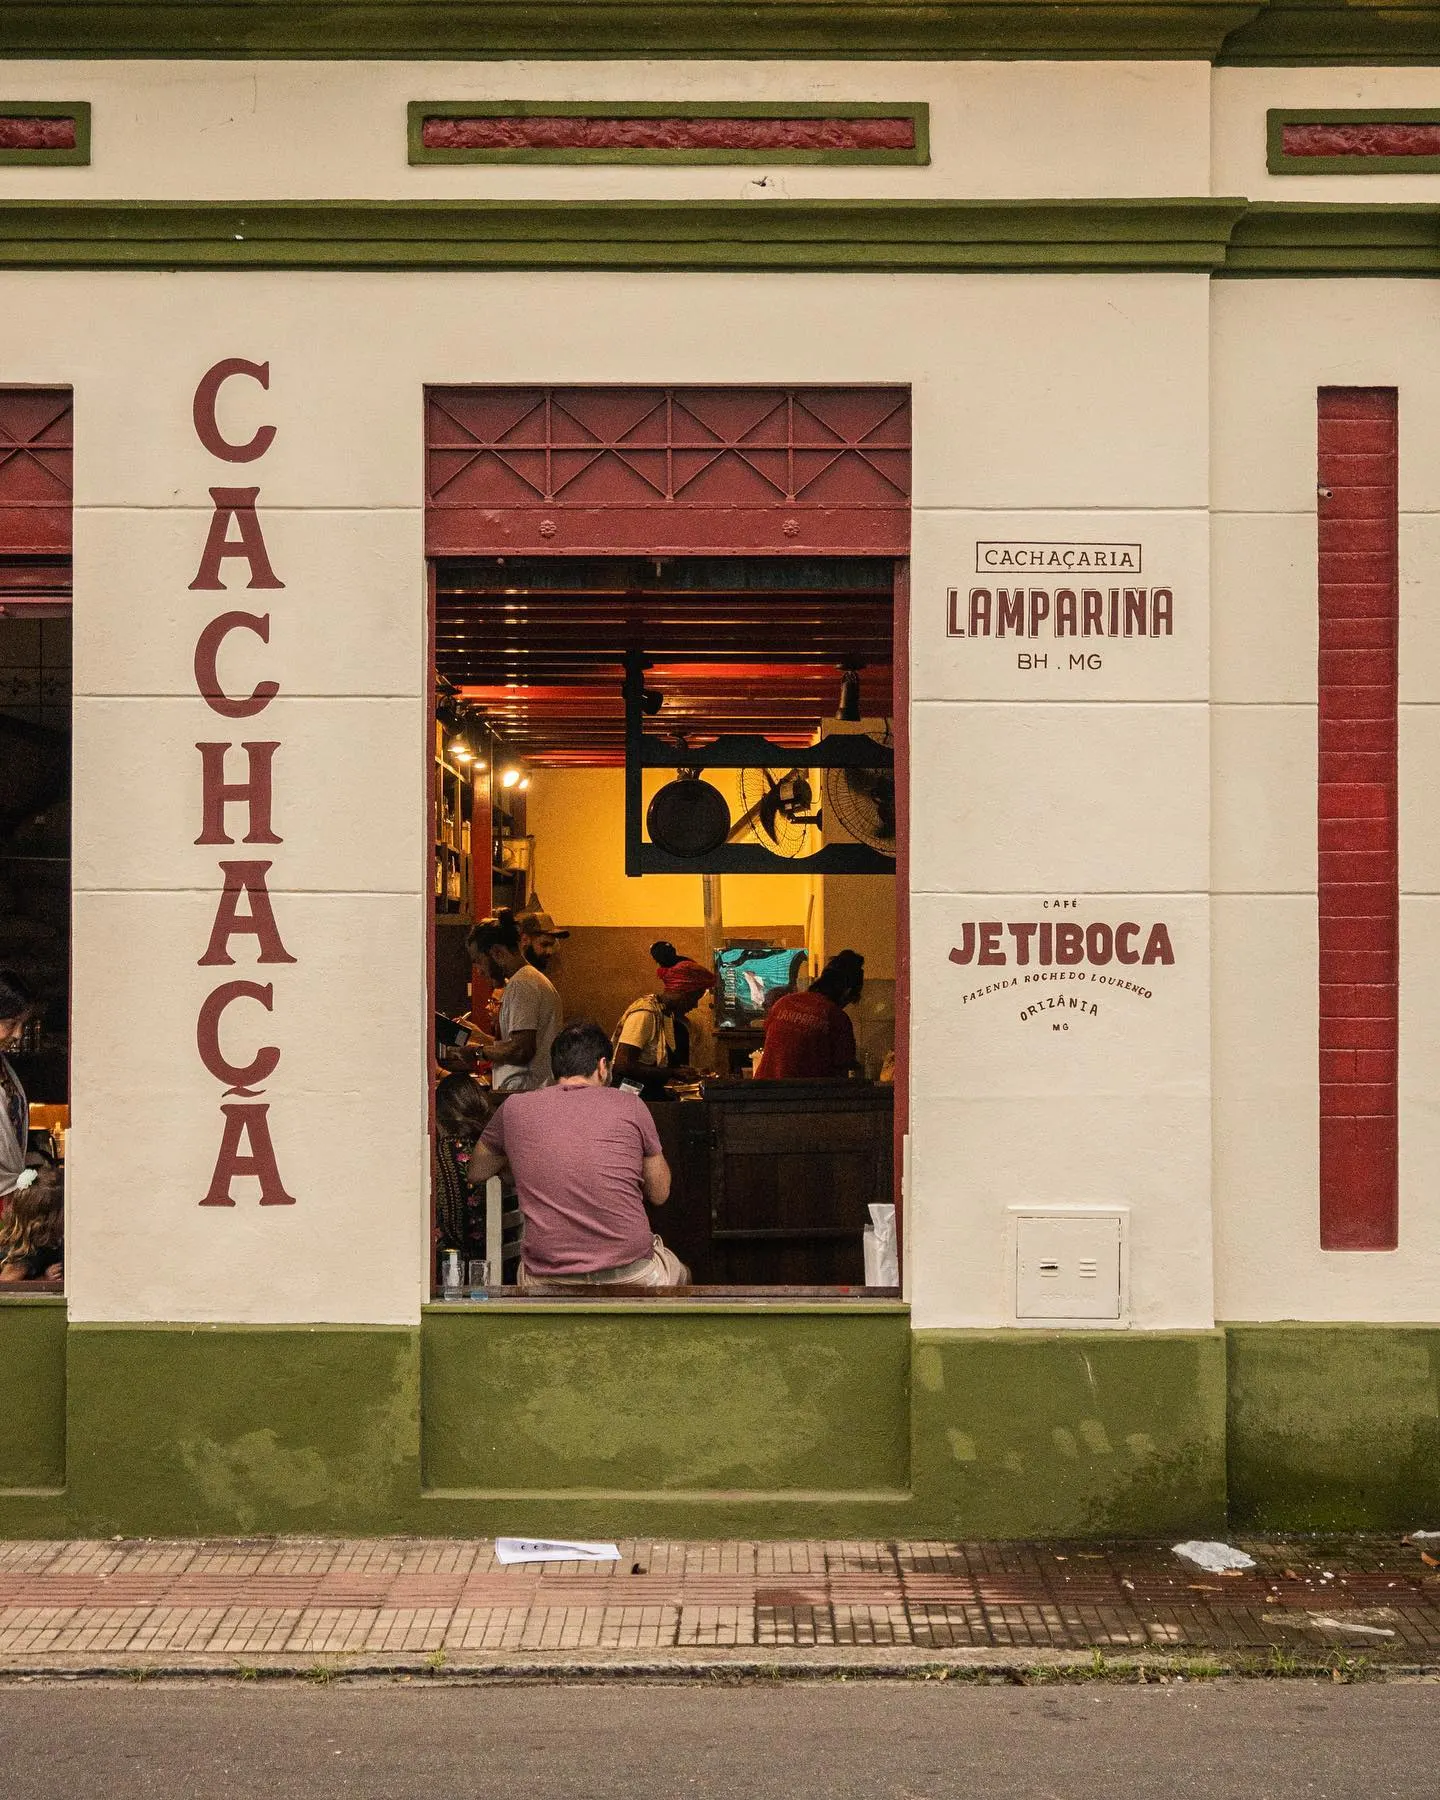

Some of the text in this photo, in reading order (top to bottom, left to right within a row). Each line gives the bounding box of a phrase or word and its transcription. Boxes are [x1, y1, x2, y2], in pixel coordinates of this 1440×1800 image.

[985, 550, 1135, 570] CACHAÇARIA
[947, 587, 1173, 639] LAMPARINA
[1017, 653, 1048, 670] BH
[1069, 653, 1102, 671] MG
[188, 358, 297, 1208] CACHAÇA
[1043, 898, 1077, 909] CAFÉ
[949, 921, 1176, 966] JETIBOCA
[962, 972, 1153, 1004] FAZENDA ROCHEDO LOURENÇO
[1020, 995, 1098, 1022] ORIZÂNIA
[1052, 1022, 1070, 1032] MG
